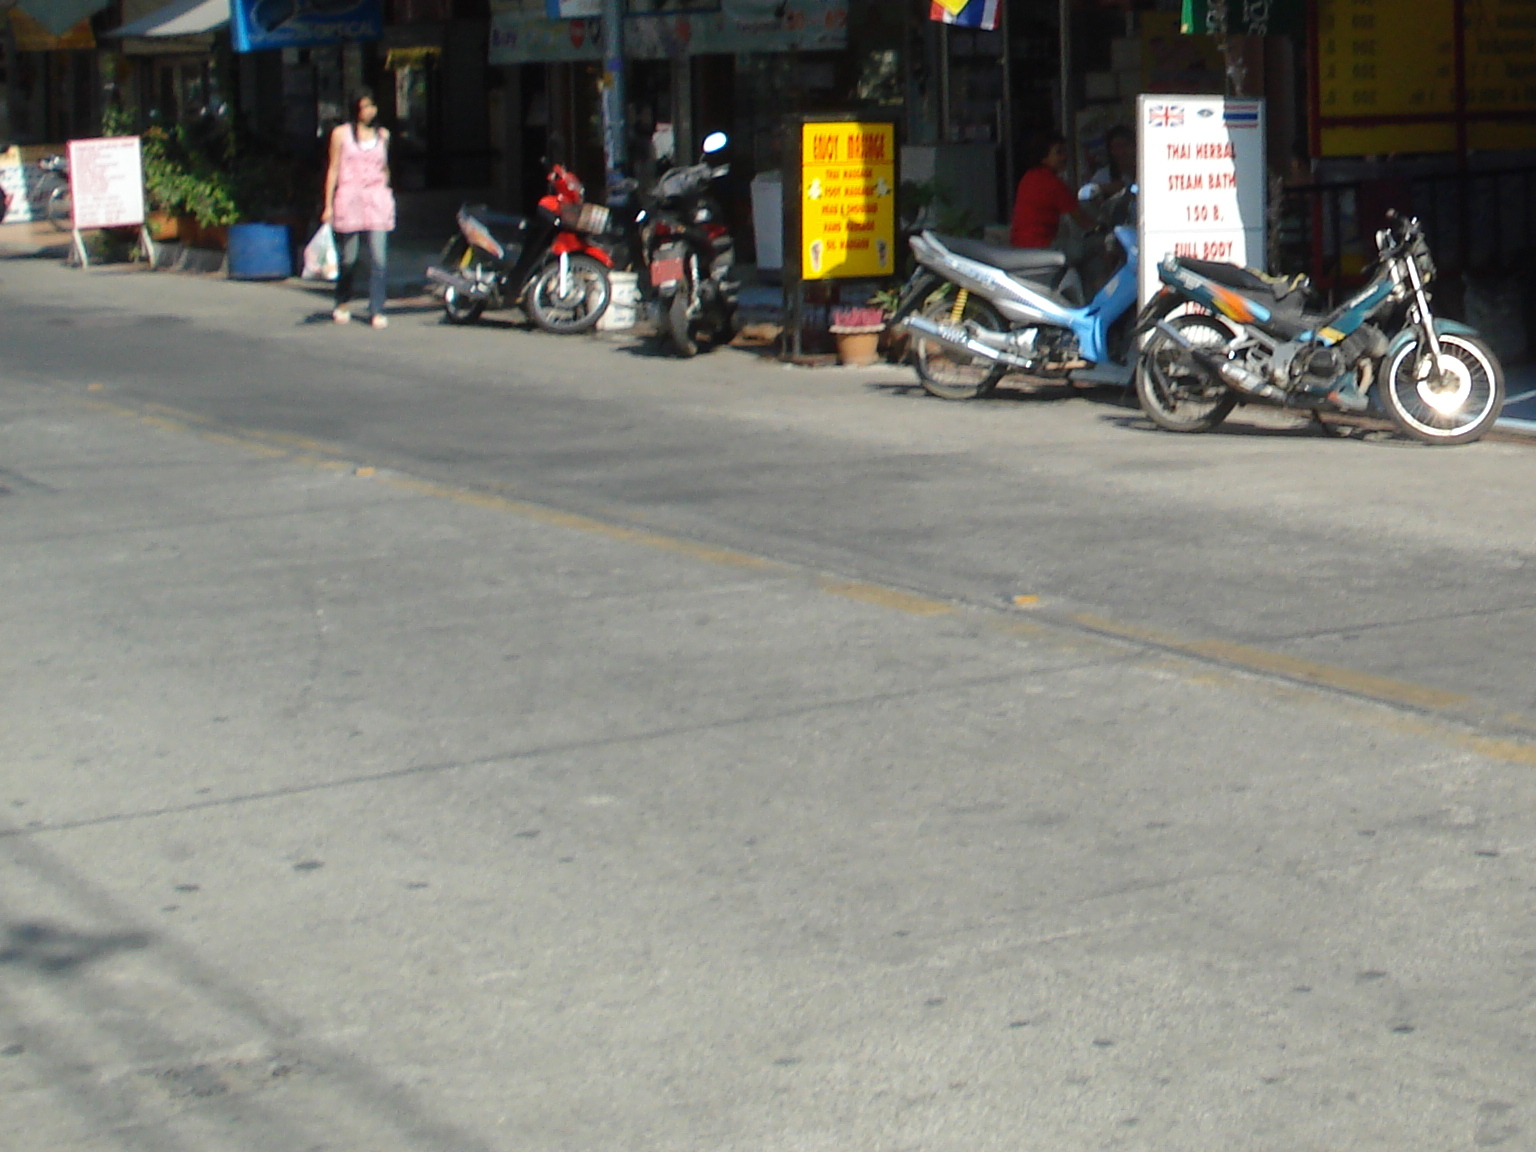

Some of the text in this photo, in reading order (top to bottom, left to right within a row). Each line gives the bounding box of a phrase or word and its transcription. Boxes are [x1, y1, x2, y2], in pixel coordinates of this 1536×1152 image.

[1166, 141, 1237, 160] THAI HERBAL
[1167, 172, 1237, 192] STEAM BATH
[1186, 204, 1209, 223] 150
[1204, 240, 1233, 259] BODY
